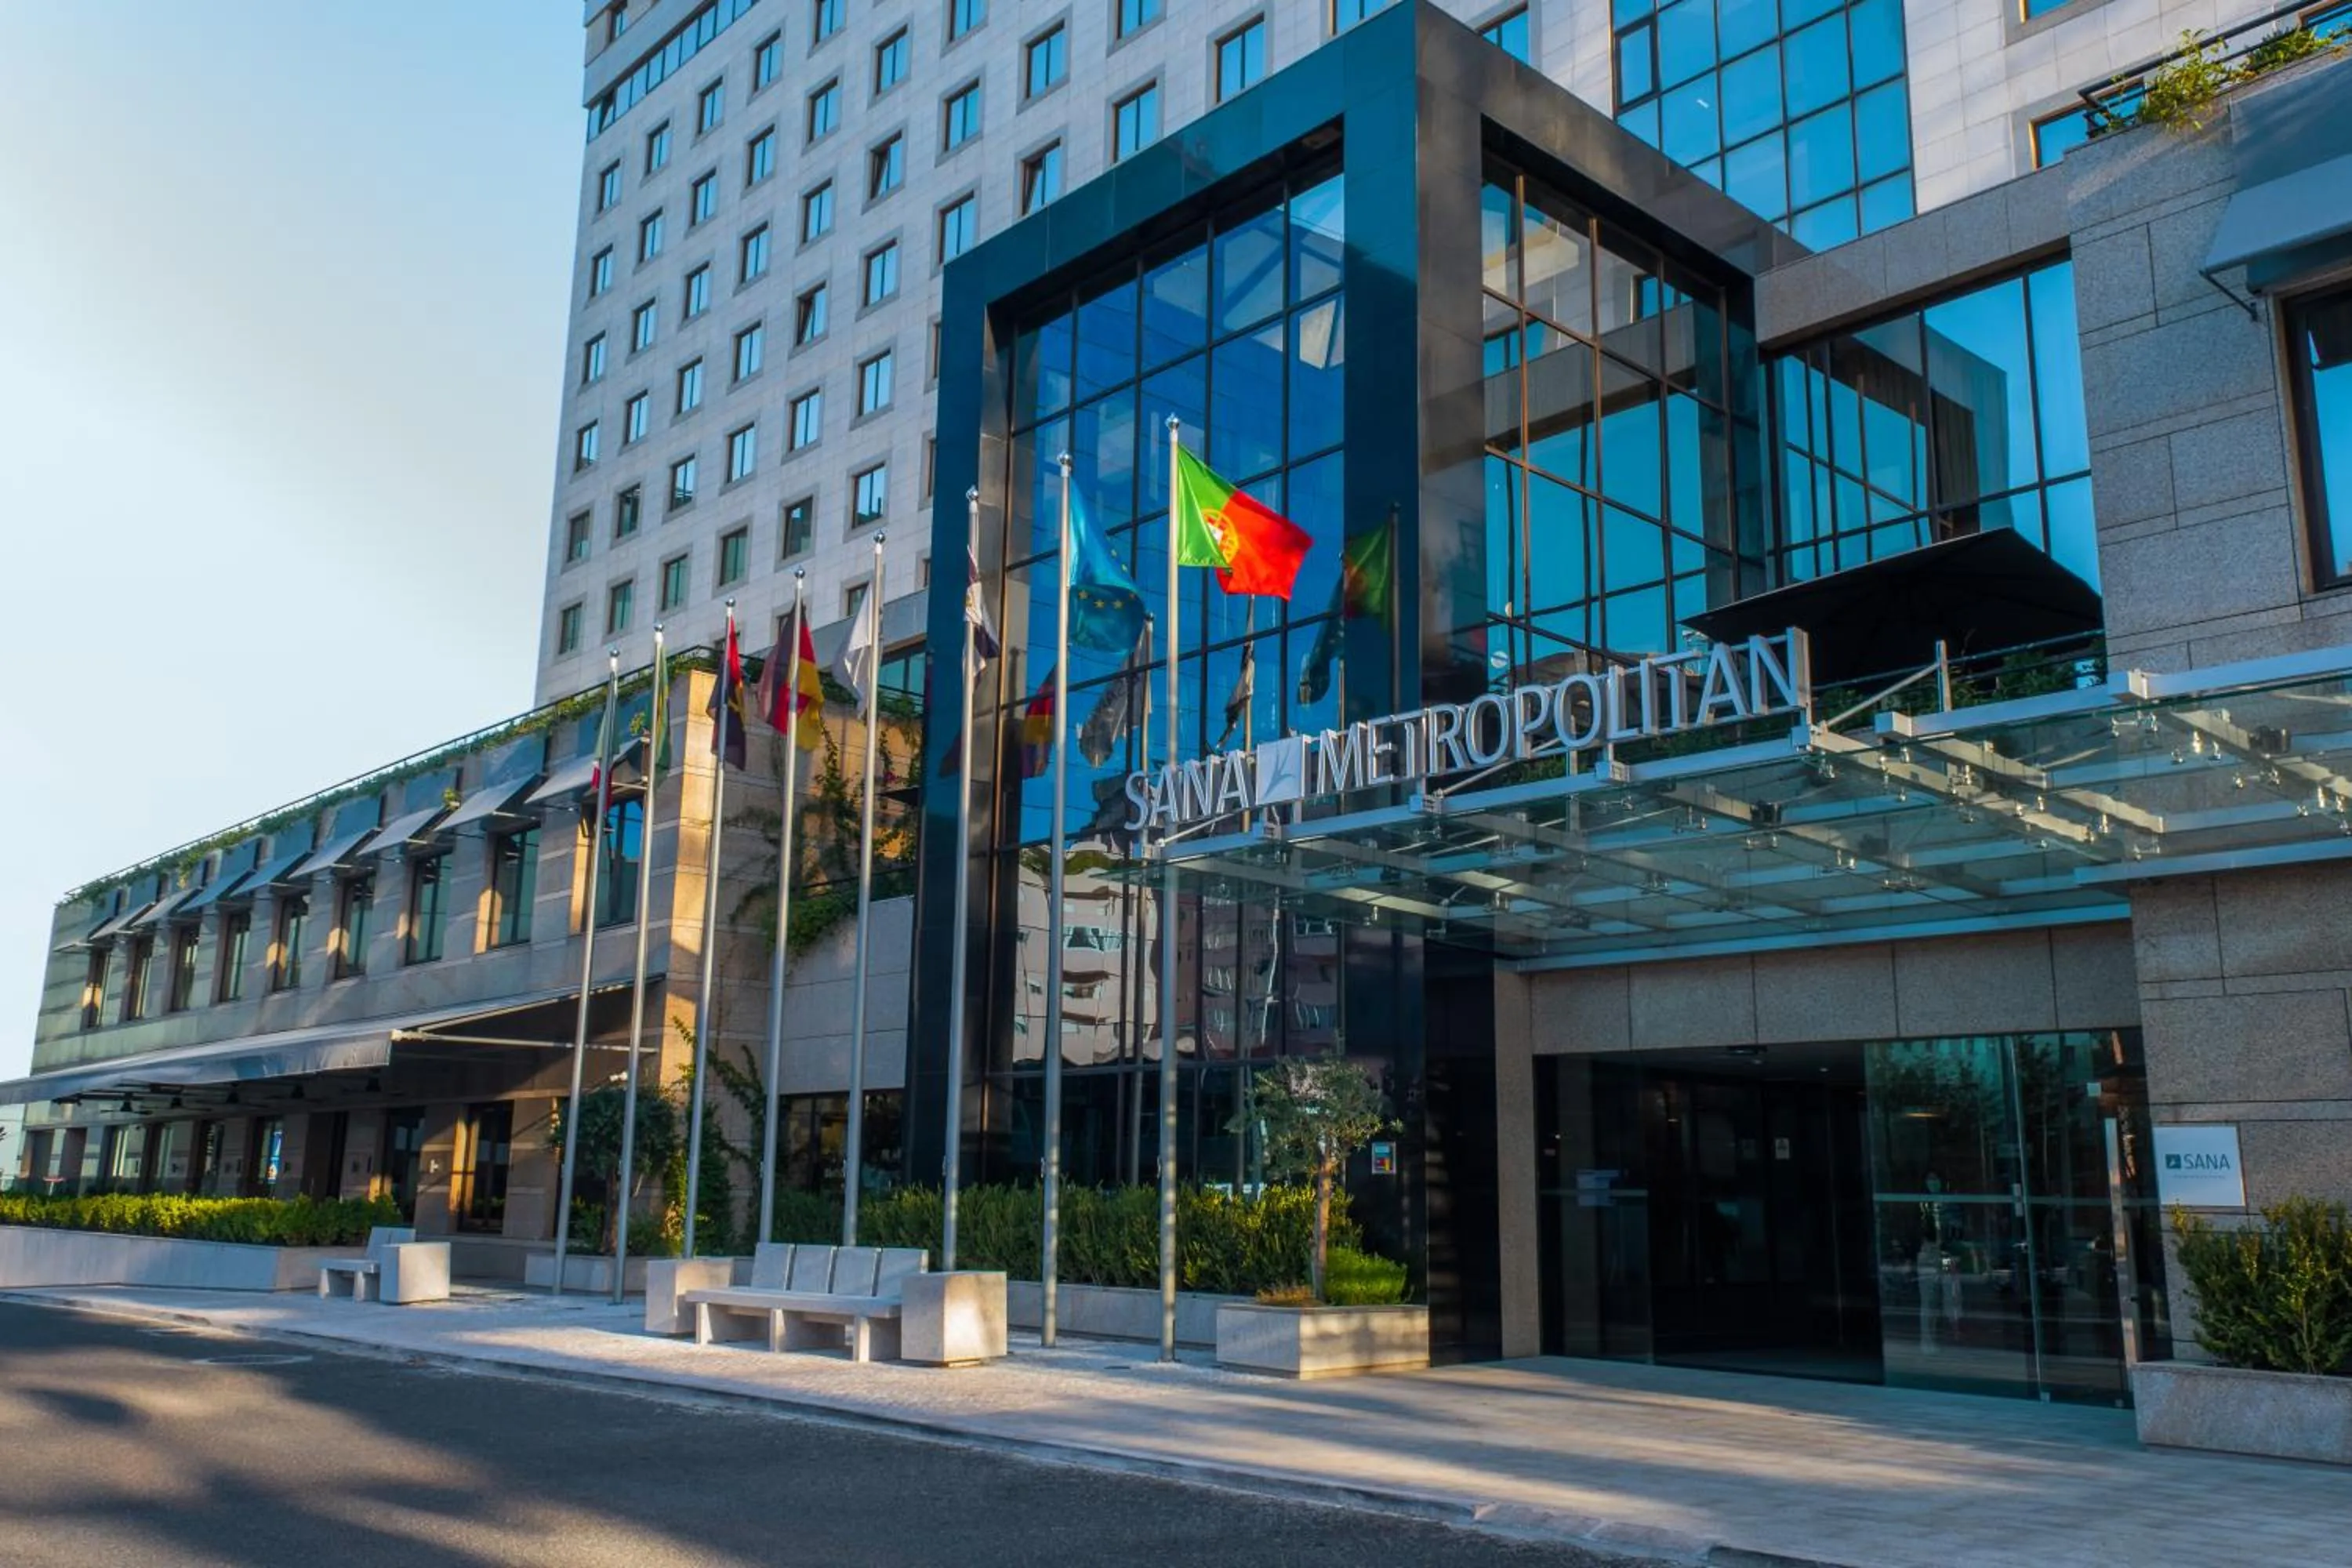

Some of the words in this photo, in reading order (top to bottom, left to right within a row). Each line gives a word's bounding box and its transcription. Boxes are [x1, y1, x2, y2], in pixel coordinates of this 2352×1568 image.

[1123, 750, 1250, 830] SANA
[1316, 626, 1808, 794] METROPOLITAN
[2183, 1153, 2230, 1170] SANA
